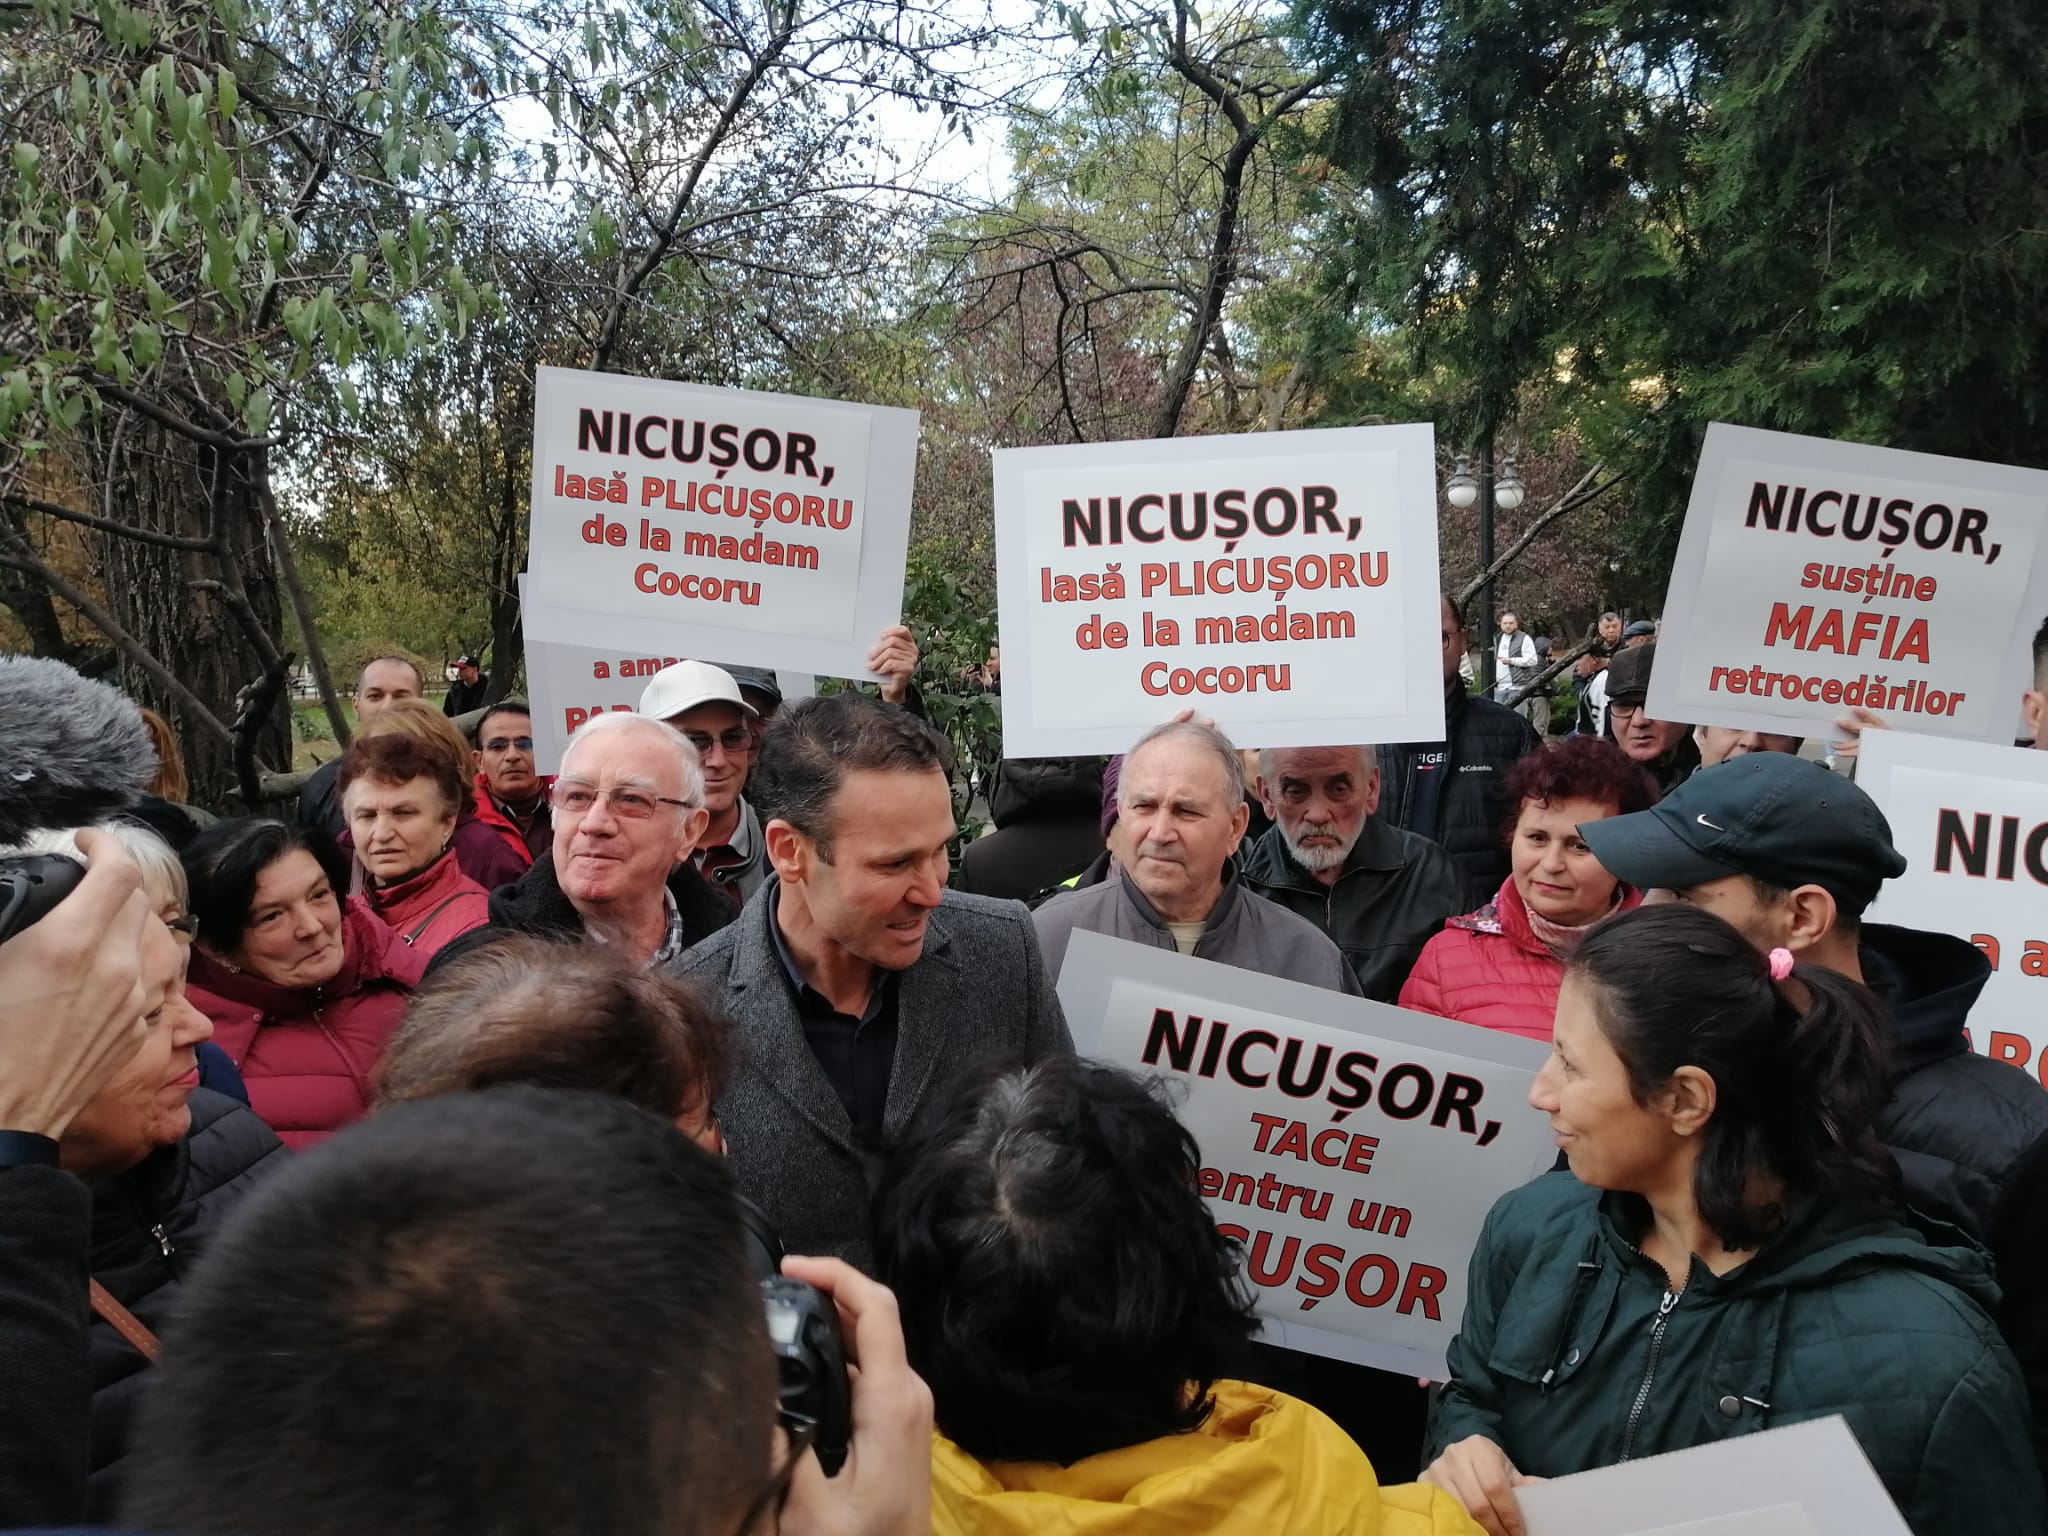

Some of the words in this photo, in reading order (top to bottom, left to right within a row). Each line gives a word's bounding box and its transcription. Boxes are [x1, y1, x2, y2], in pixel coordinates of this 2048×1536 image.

[577, 407, 836, 487] NICUȘOR,
[554, 465, 629, 504] lasă
[641, 476, 854, 530] PLICUȘORU
[1062, 485, 1363, 554] NICUȘOR,
[1744, 482, 2003, 565] NICUȘOR,
[581, 513, 627, 547] de
[639, 519, 671, 553] la
[684, 532, 820, 570] madam
[634, 563, 762, 606] Cocoru
[1041, 563, 1126, 603] lasă
[1140, 551, 1389, 602] PLICUȘORU
[1800, 562, 1938, 604] susține
[1075, 614, 1128, 650] de
[1142, 610, 1180, 647] la
[1195, 605, 1356, 645] madam
[1764, 602, 1931, 664] MAFIA
[593, 660, 610, 679] a
[1140, 661, 1292, 697] Cocoru
[1709, 665, 1966, 717] retrocedărilor
[1140, 1008, 1503, 1147] NICUȘOR,
[1250, 1112, 1380, 1174] TACE
[1199, 1167, 1334, 1222] entru
[1347, 1198, 1412, 1238] un
